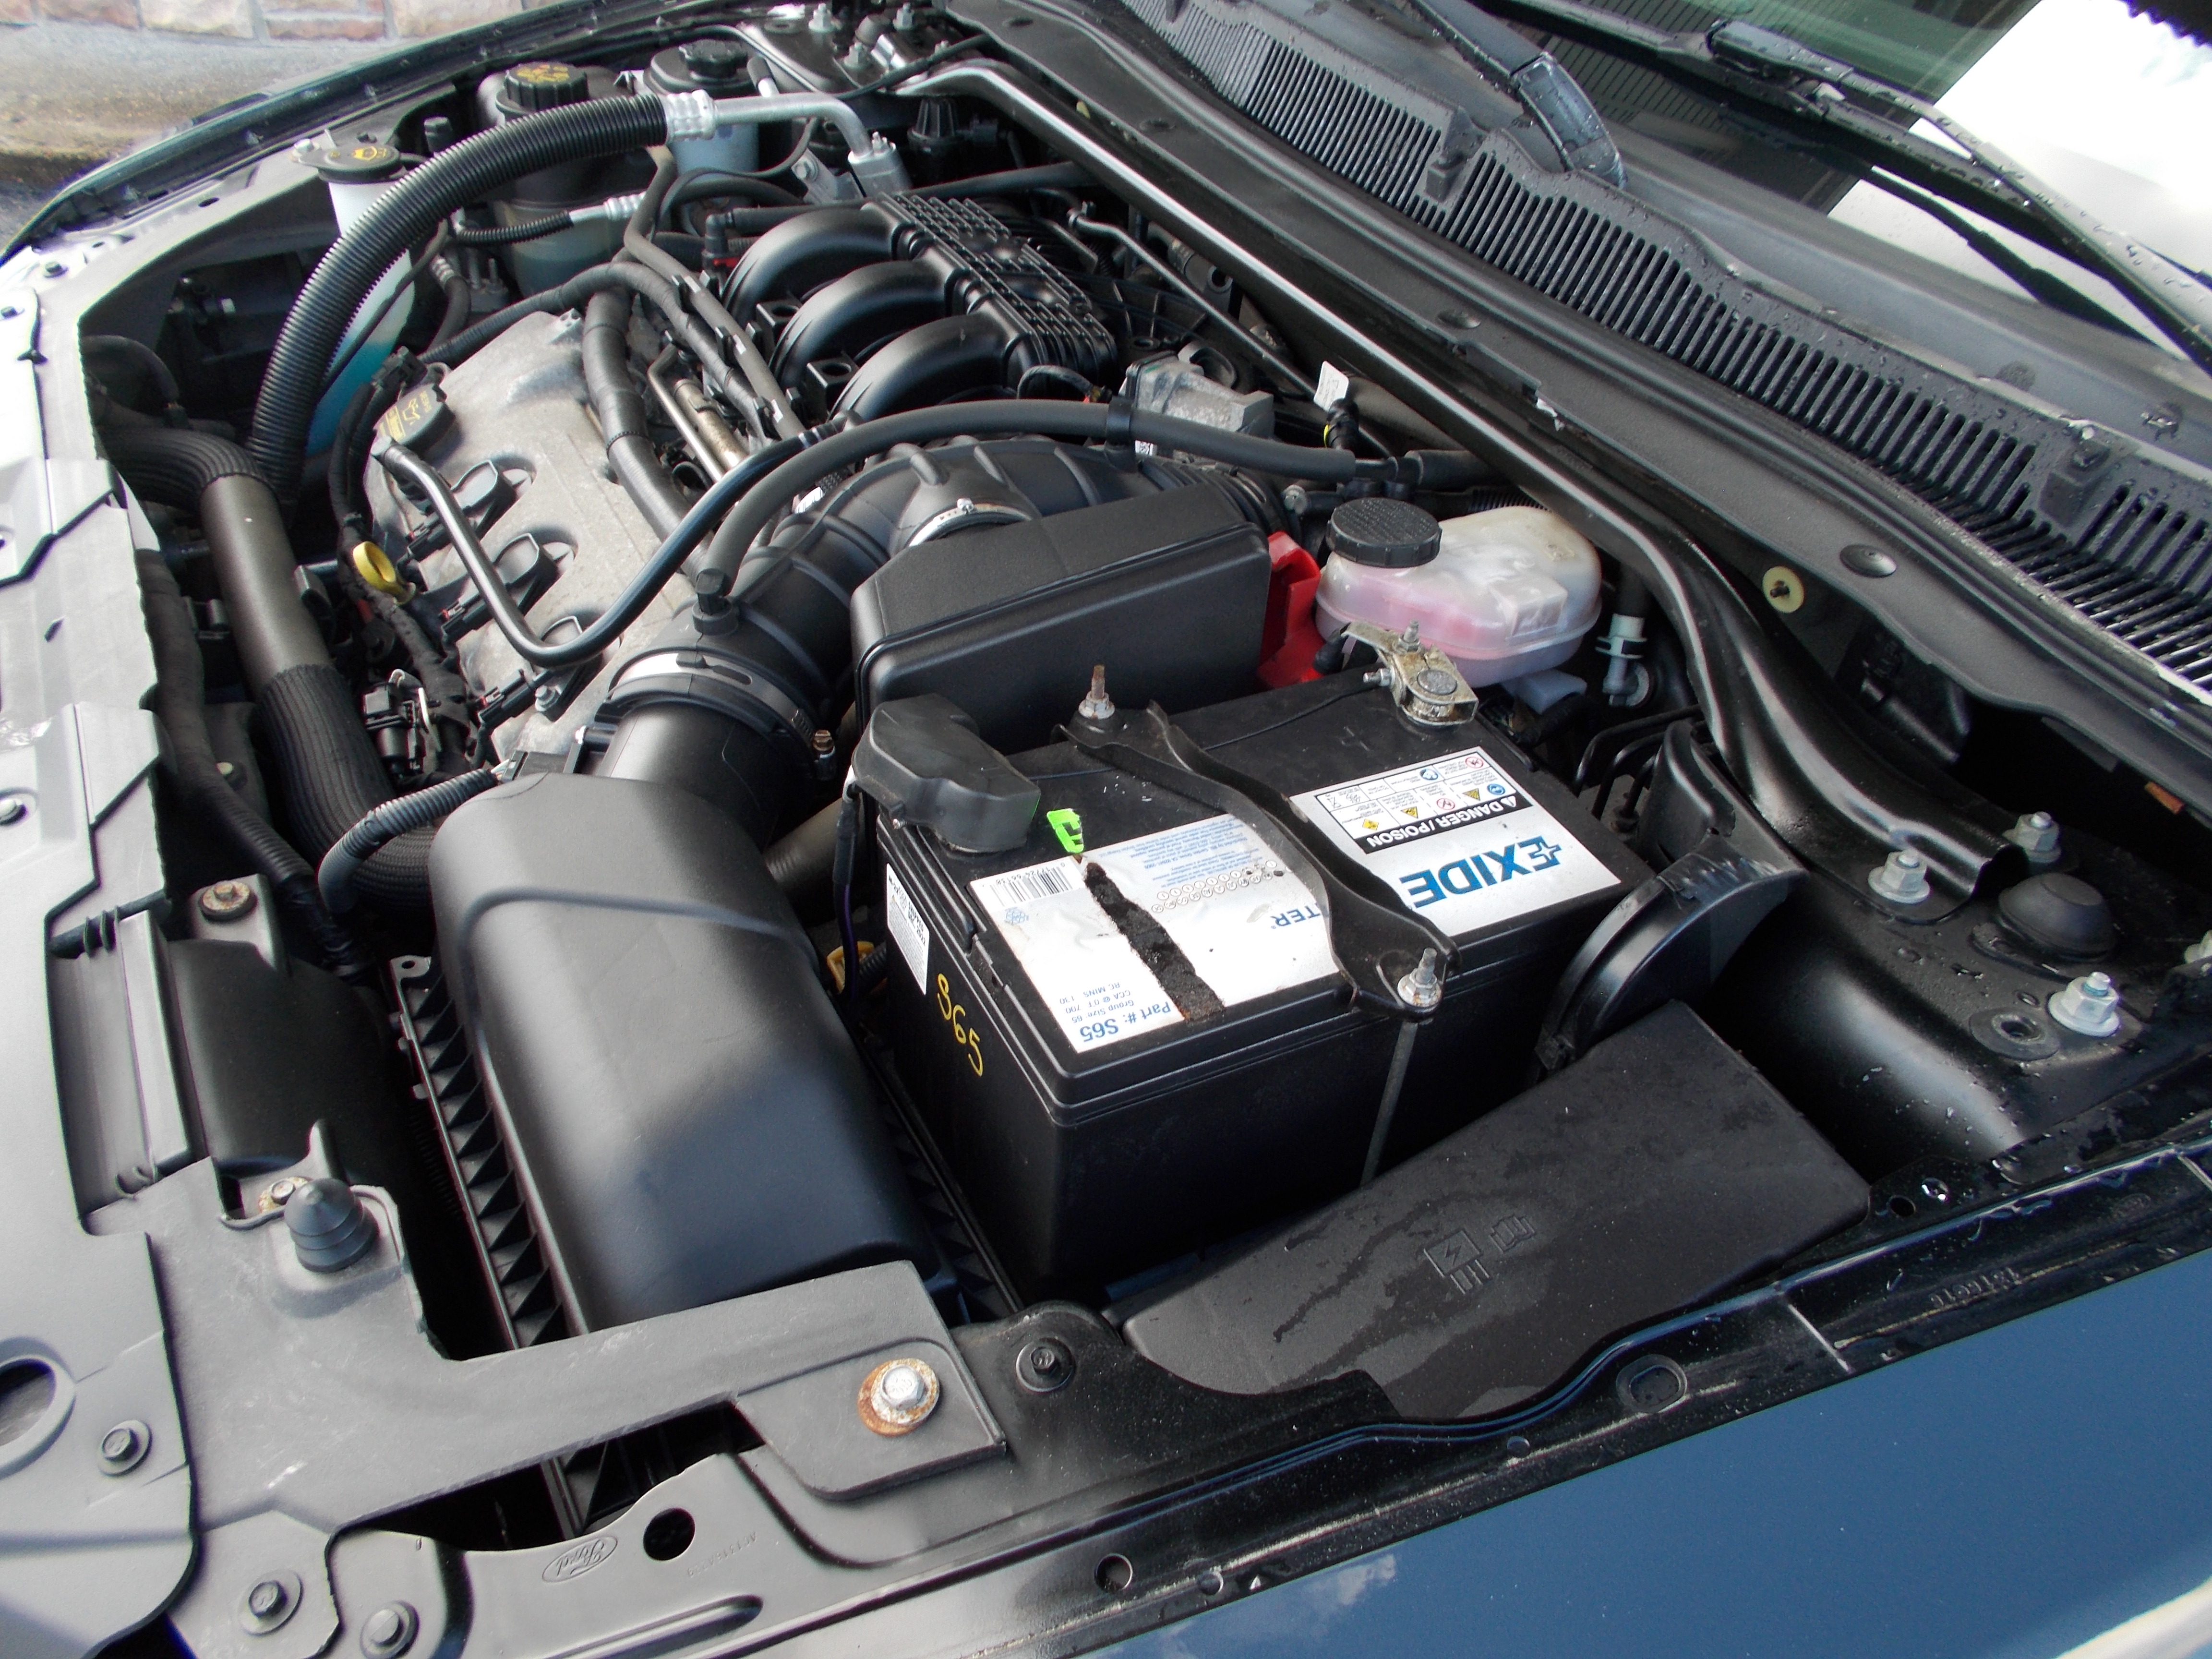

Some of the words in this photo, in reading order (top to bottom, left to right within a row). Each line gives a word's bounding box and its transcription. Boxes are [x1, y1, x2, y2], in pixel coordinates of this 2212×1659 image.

[1435, 802, 1503, 827] DANGER
[1399, 835, 1562, 908] EXIDE
[1083, 986, 1106, 997] MINS
[1113, 990, 1131, 998] CCA
[1059, 996, 1074, 1004] 130
[1108, 1000, 1134, 1011] Group
[1066, 1005, 1081, 1013] 700
[1086, 1009, 1106, 1017] Size:
[1142, 1001, 1171, 1019] Part
[1124, 1012, 1136, 1024] #:
[1080, 1018, 1119, 1043] S65
[556, 1539, 605, 1576] Ford
